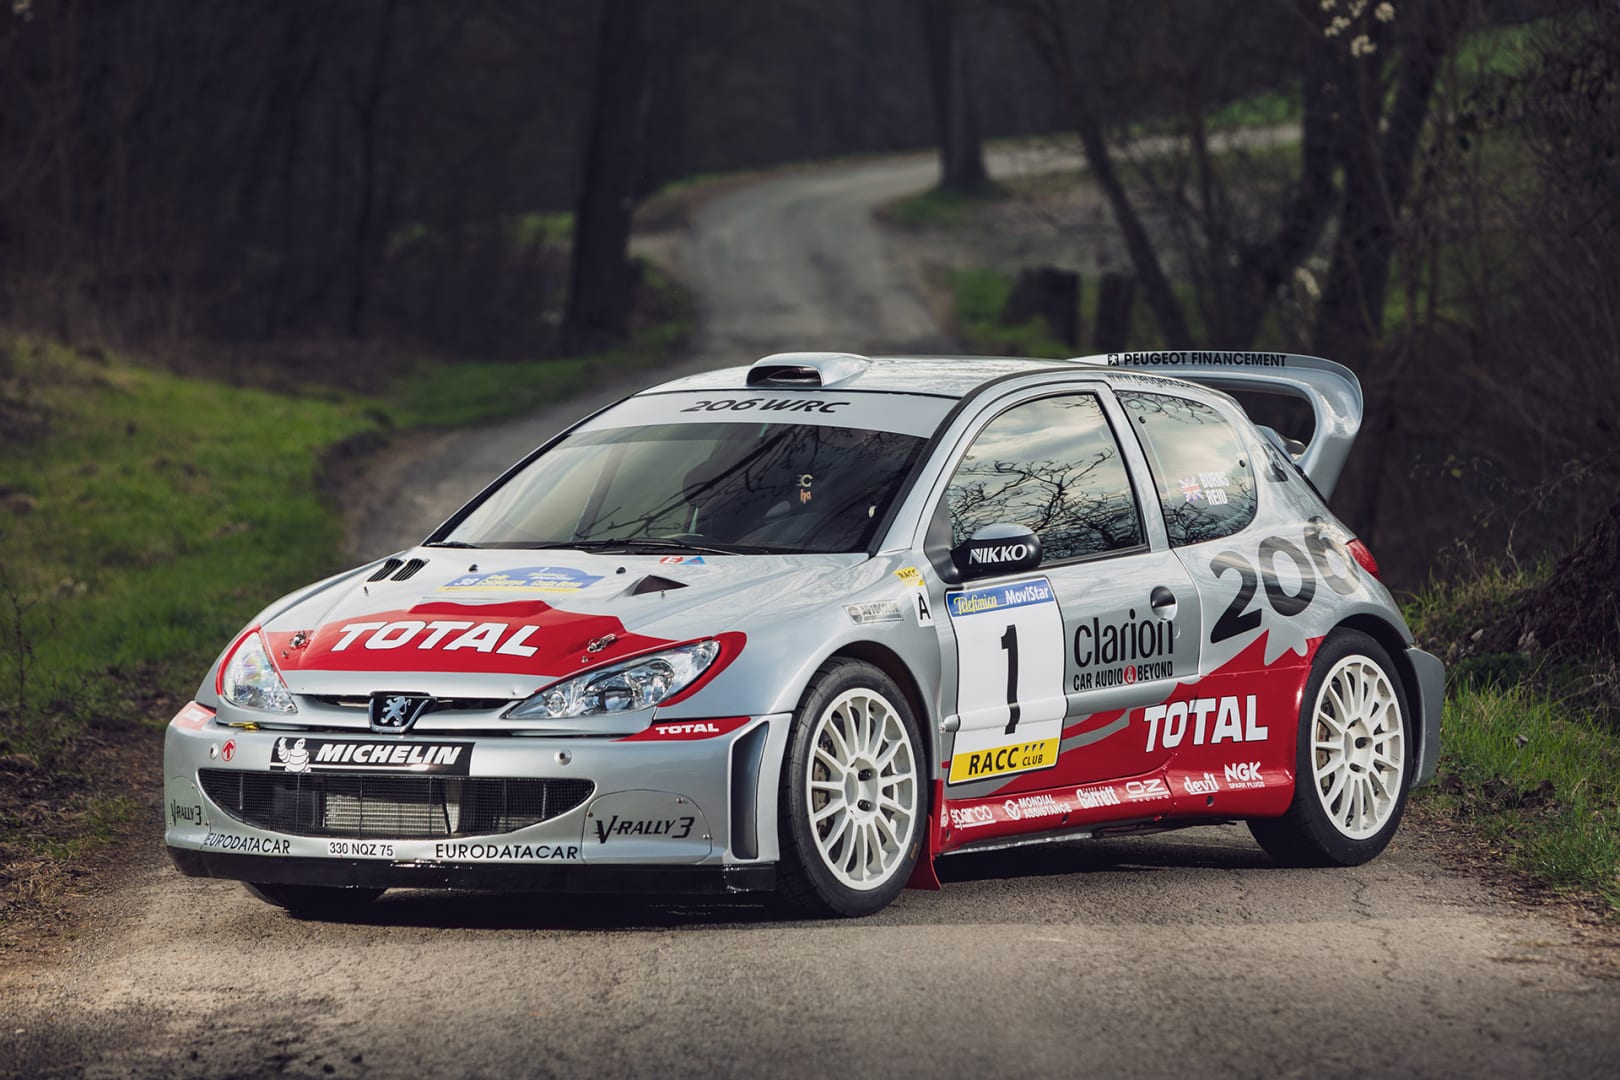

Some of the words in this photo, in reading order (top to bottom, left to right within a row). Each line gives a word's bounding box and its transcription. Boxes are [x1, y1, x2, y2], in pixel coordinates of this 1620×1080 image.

[1124, 352, 1187, 366] PEUGEOT
[1191, 352, 1287, 367] FINANCEMENT
[968, 543, 1028, 565] NIKKO
[1210, 514, 1361, 644] 206
[917, 591, 931, 621] A
[1004, 585, 1050, 605] MoviStar
[330, 621, 541, 658] TOTAL
[1073, 608, 1174, 668] clarion
[1000, 624, 1021, 735] 1
[1073, 672, 1093, 692] CAR
[1095, 667, 1123, 688] AUDIO
[1137, 660, 1173, 682] BEYOND
[655, 723, 720, 736] TOTAL
[1143, 695, 1269, 753] TOTAL
[315, 743, 463, 766] MICHELIN
[968, 747, 1020, 776] RACC
[1022, 754, 1044, 767] CLUB
[1224, 761, 1263, 782] NGK
[1183, 772, 1220, 796] devil
[1018, 794, 1055, 810] MONDIAL
[1076, 785, 1121, 809] Garrett
[1023, 803, 1073, 819] ASSISTANCE
[672, 817, 695, 838] 3
[204, 832, 291, 855] EURODATACAR
[329, 842, 348, 855] 330
[351, 843, 377, 856] NQZ
[380, 845, 394, 857] 75
[435, 843, 579, 860] EURODATACAR
